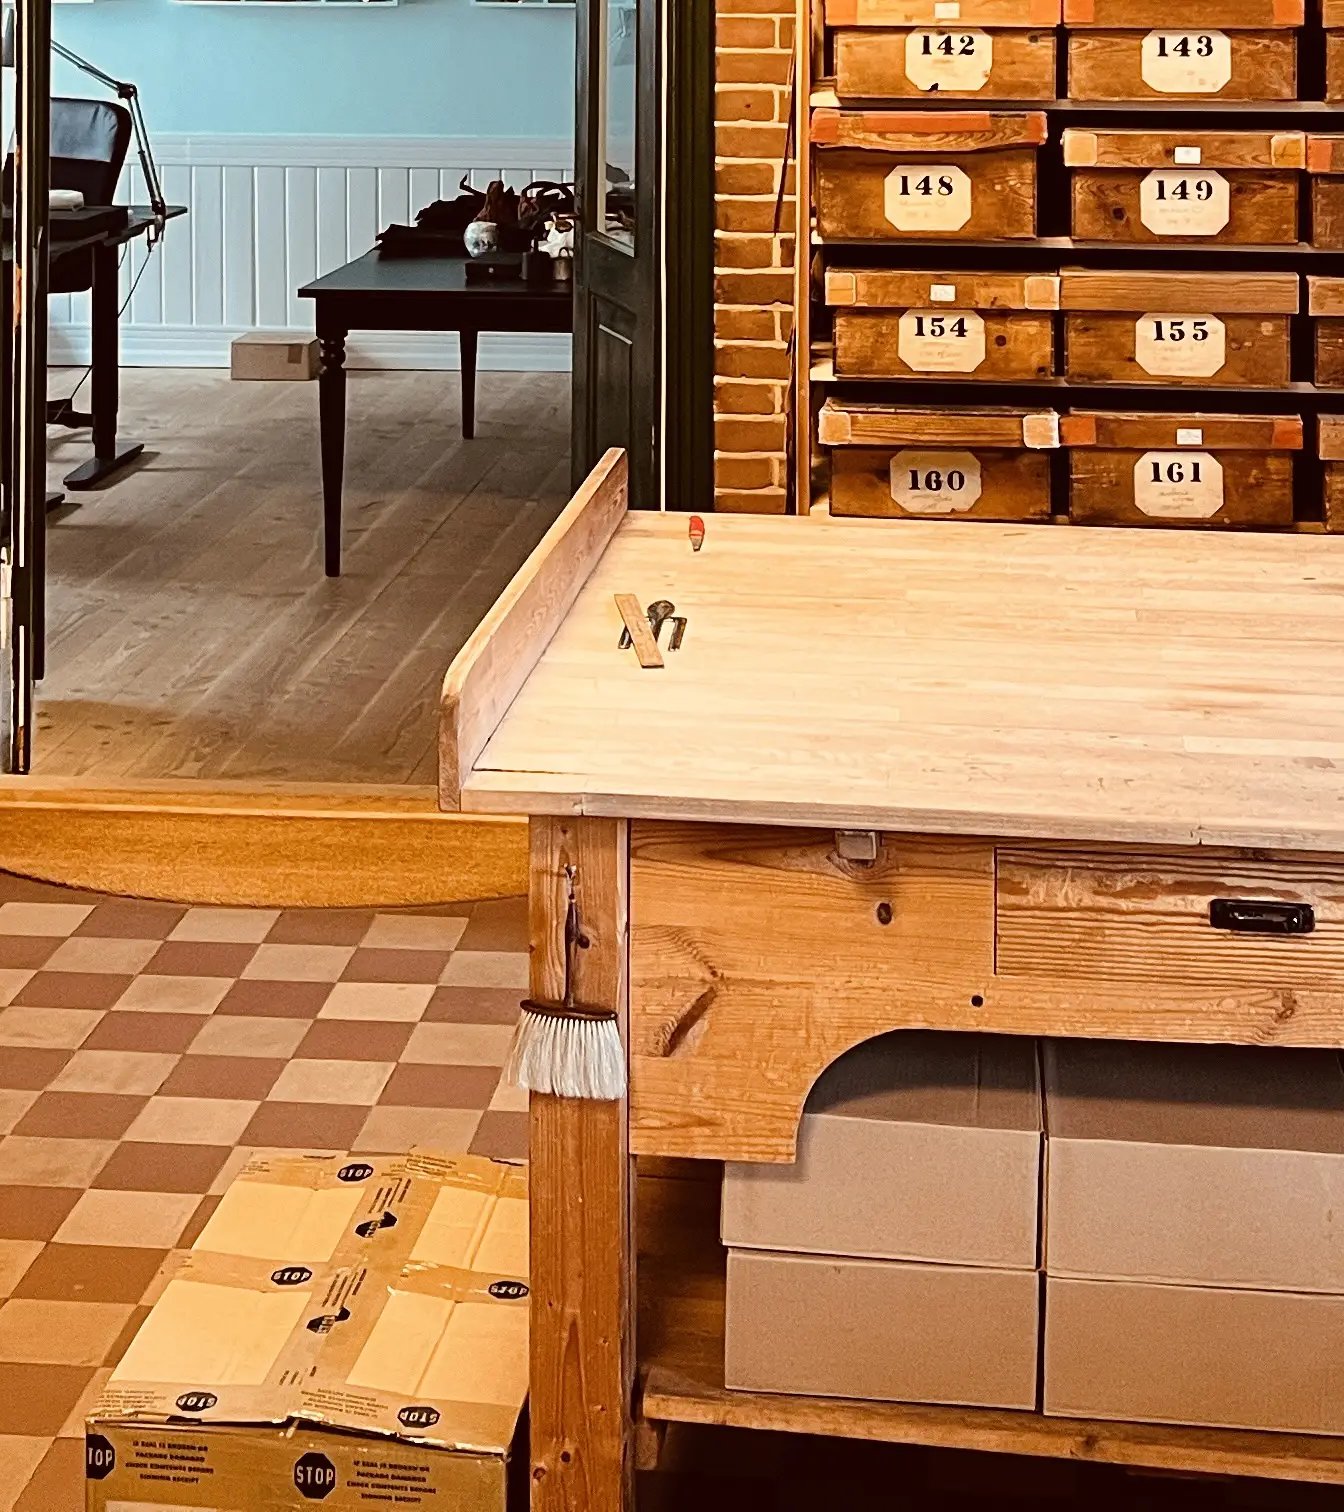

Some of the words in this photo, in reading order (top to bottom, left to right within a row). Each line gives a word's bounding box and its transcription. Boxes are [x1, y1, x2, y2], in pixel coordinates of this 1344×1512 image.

[921, 34, 975, 56] 142
[1157, 35, 1214, 57] 143
[899, 175, 954, 196] 148
[1155, 179, 1213, 201] 149
[914, 315, 969, 338] 154
[1153, 320, 1209, 342] 155
[908, 469, 965, 492] 160
[1150, 461, 1202, 483] 161
[272, 1270, 310, 1281] STOP
[176, 1395, 216, 1407] STOP
[399, 1410, 438, 1423] STOP
[87, 1446, 113, 1467] TOP
[295, 1465, 335, 1486] STOP
